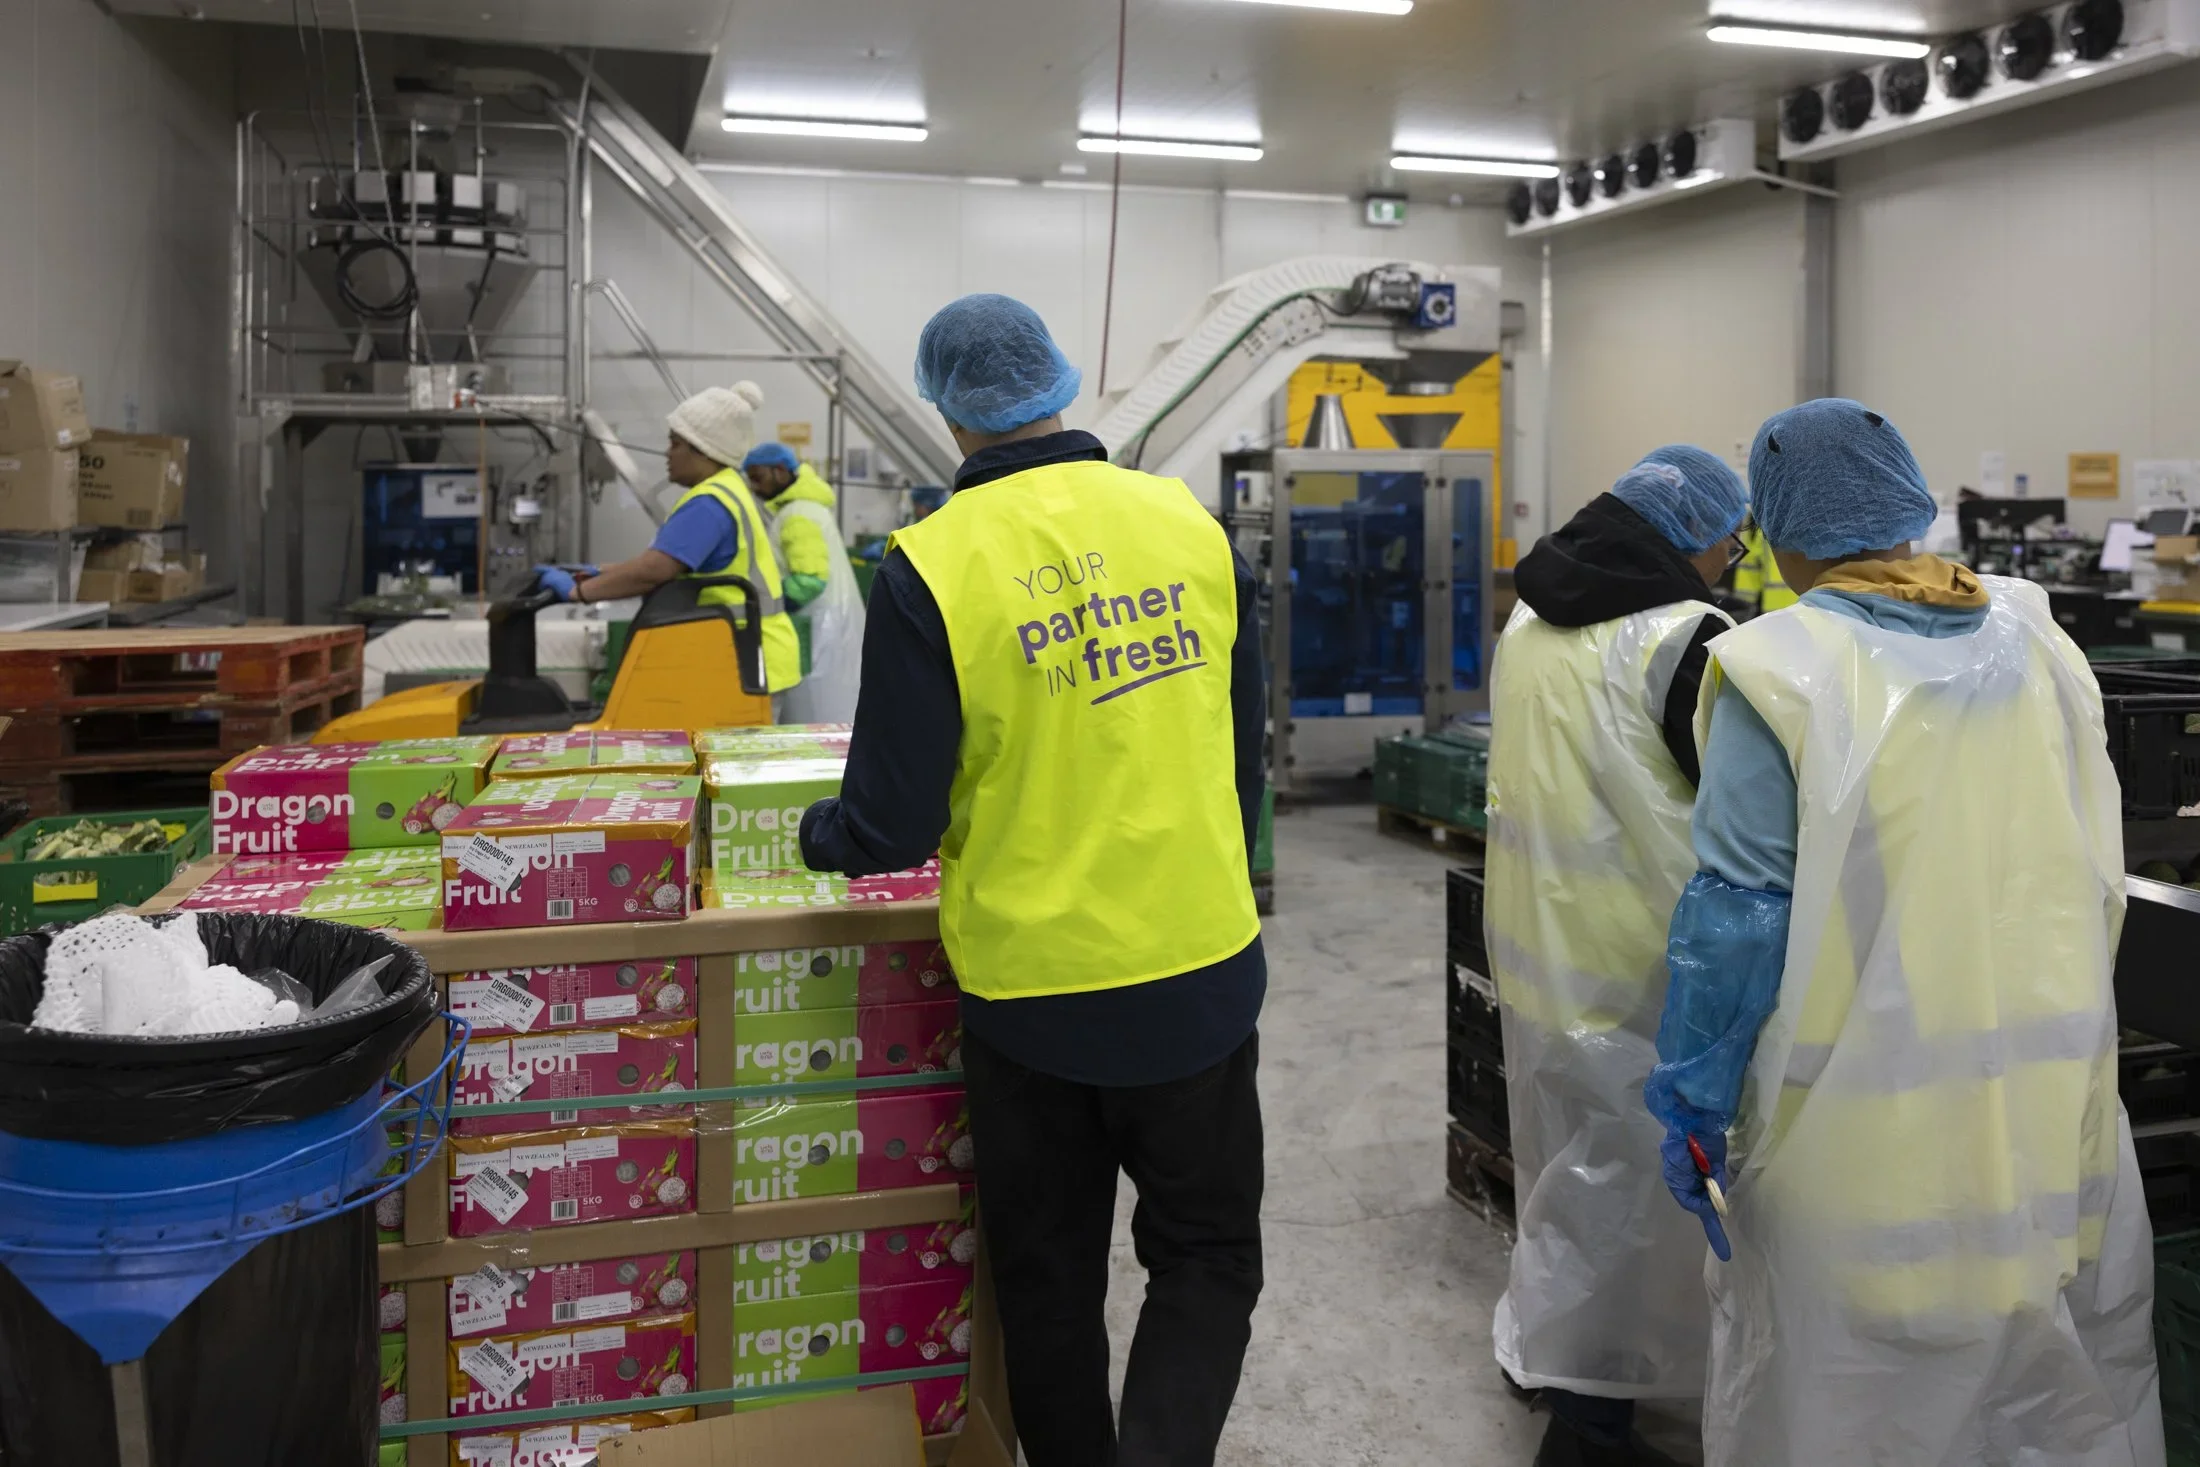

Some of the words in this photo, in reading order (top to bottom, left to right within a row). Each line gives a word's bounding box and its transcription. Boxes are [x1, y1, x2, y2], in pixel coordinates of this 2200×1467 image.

[1014, 552, 1107, 599] YOUR
[1016, 582, 1185, 664] partner
[1047, 660, 1076, 696] IN
[1082, 619, 1201, 681] fresh
[213, 790, 355, 826] Dragon
[711, 802, 805, 837] Drag
[212, 822, 298, 854] Fruit
[472, 836, 515, 866] DRG0000145
[711, 836, 797, 871] Fruit
[297, 855, 441, 871] ragon
[578, 897, 598, 907] 5KG
[723, 890, 894, 908] Dragon
[738, 945, 865, 979] ragon
[491, 979, 533, 1008] DRG0000145
[734, 977, 800, 1013] ruit
[517, 1042, 561, 1052] NEWZEALAND
[736, 1036, 863, 1075] ragon
[516, 1151, 560, 1161] NEWZEALAND
[737, 1129, 864, 1169] ragon
[481, 1166, 519, 1200] DRG0000145
[733, 1167, 799, 1203] ruit
[583, 1195, 602, 1206] 5KG
[738, 1231, 865, 1268] ragon
[734, 1266, 801, 1304] ruit
[458, 1312, 501, 1326] NEWZEALAND
[523, 1342, 566, 1352] NEWZEALAND
[738, 1318, 865, 1361] ragon
[479, 1342, 517, 1377] DRG0000145
[733, 1359, 800, 1389] ruit
